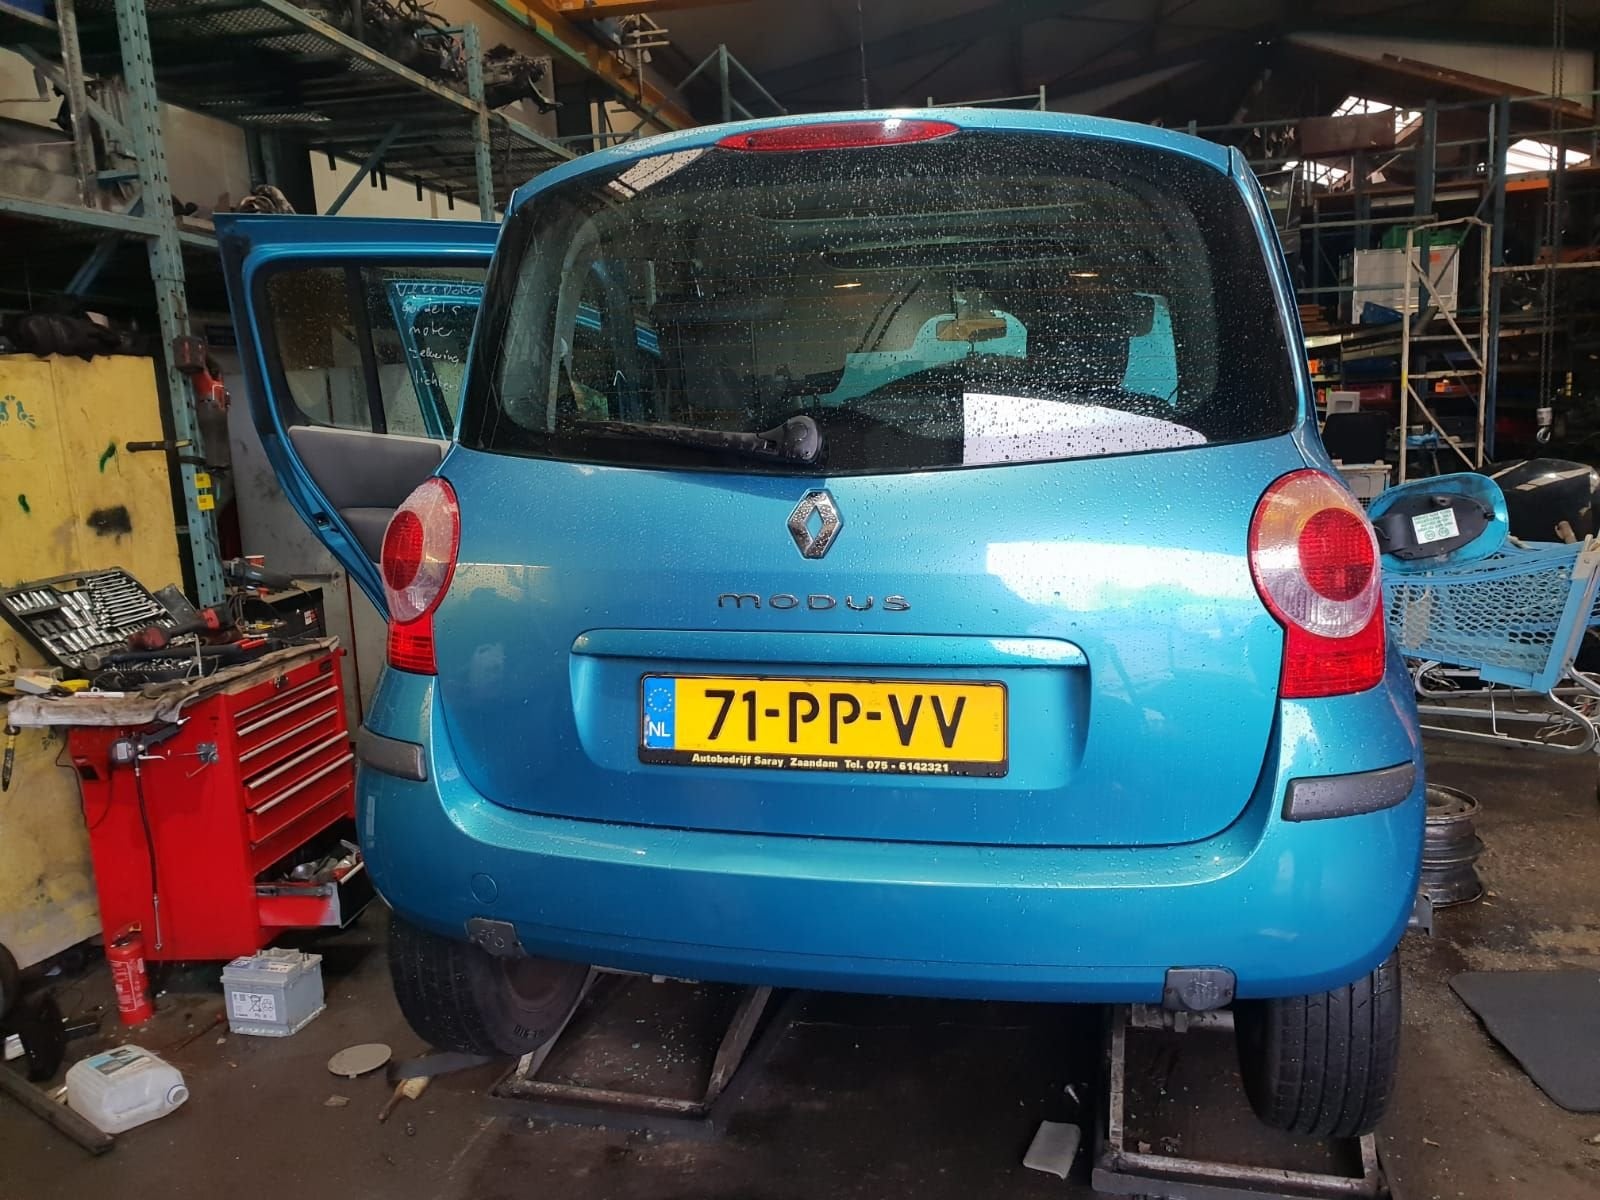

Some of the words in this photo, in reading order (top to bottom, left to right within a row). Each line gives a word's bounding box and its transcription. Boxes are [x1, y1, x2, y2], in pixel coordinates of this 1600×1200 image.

[704, 689, 966, 748] 71-PP-VV
[648, 722, 671, 738] NL
[692, 753, 751, 765] Autobedrijf
[754, 754, 784, 768] Saray
[790, 757, 838, 769] Zaandam
[844, 759, 864, 769] Tel.
[866, 760, 888, 770] 075
[899, 762, 949, 773] 6142321
